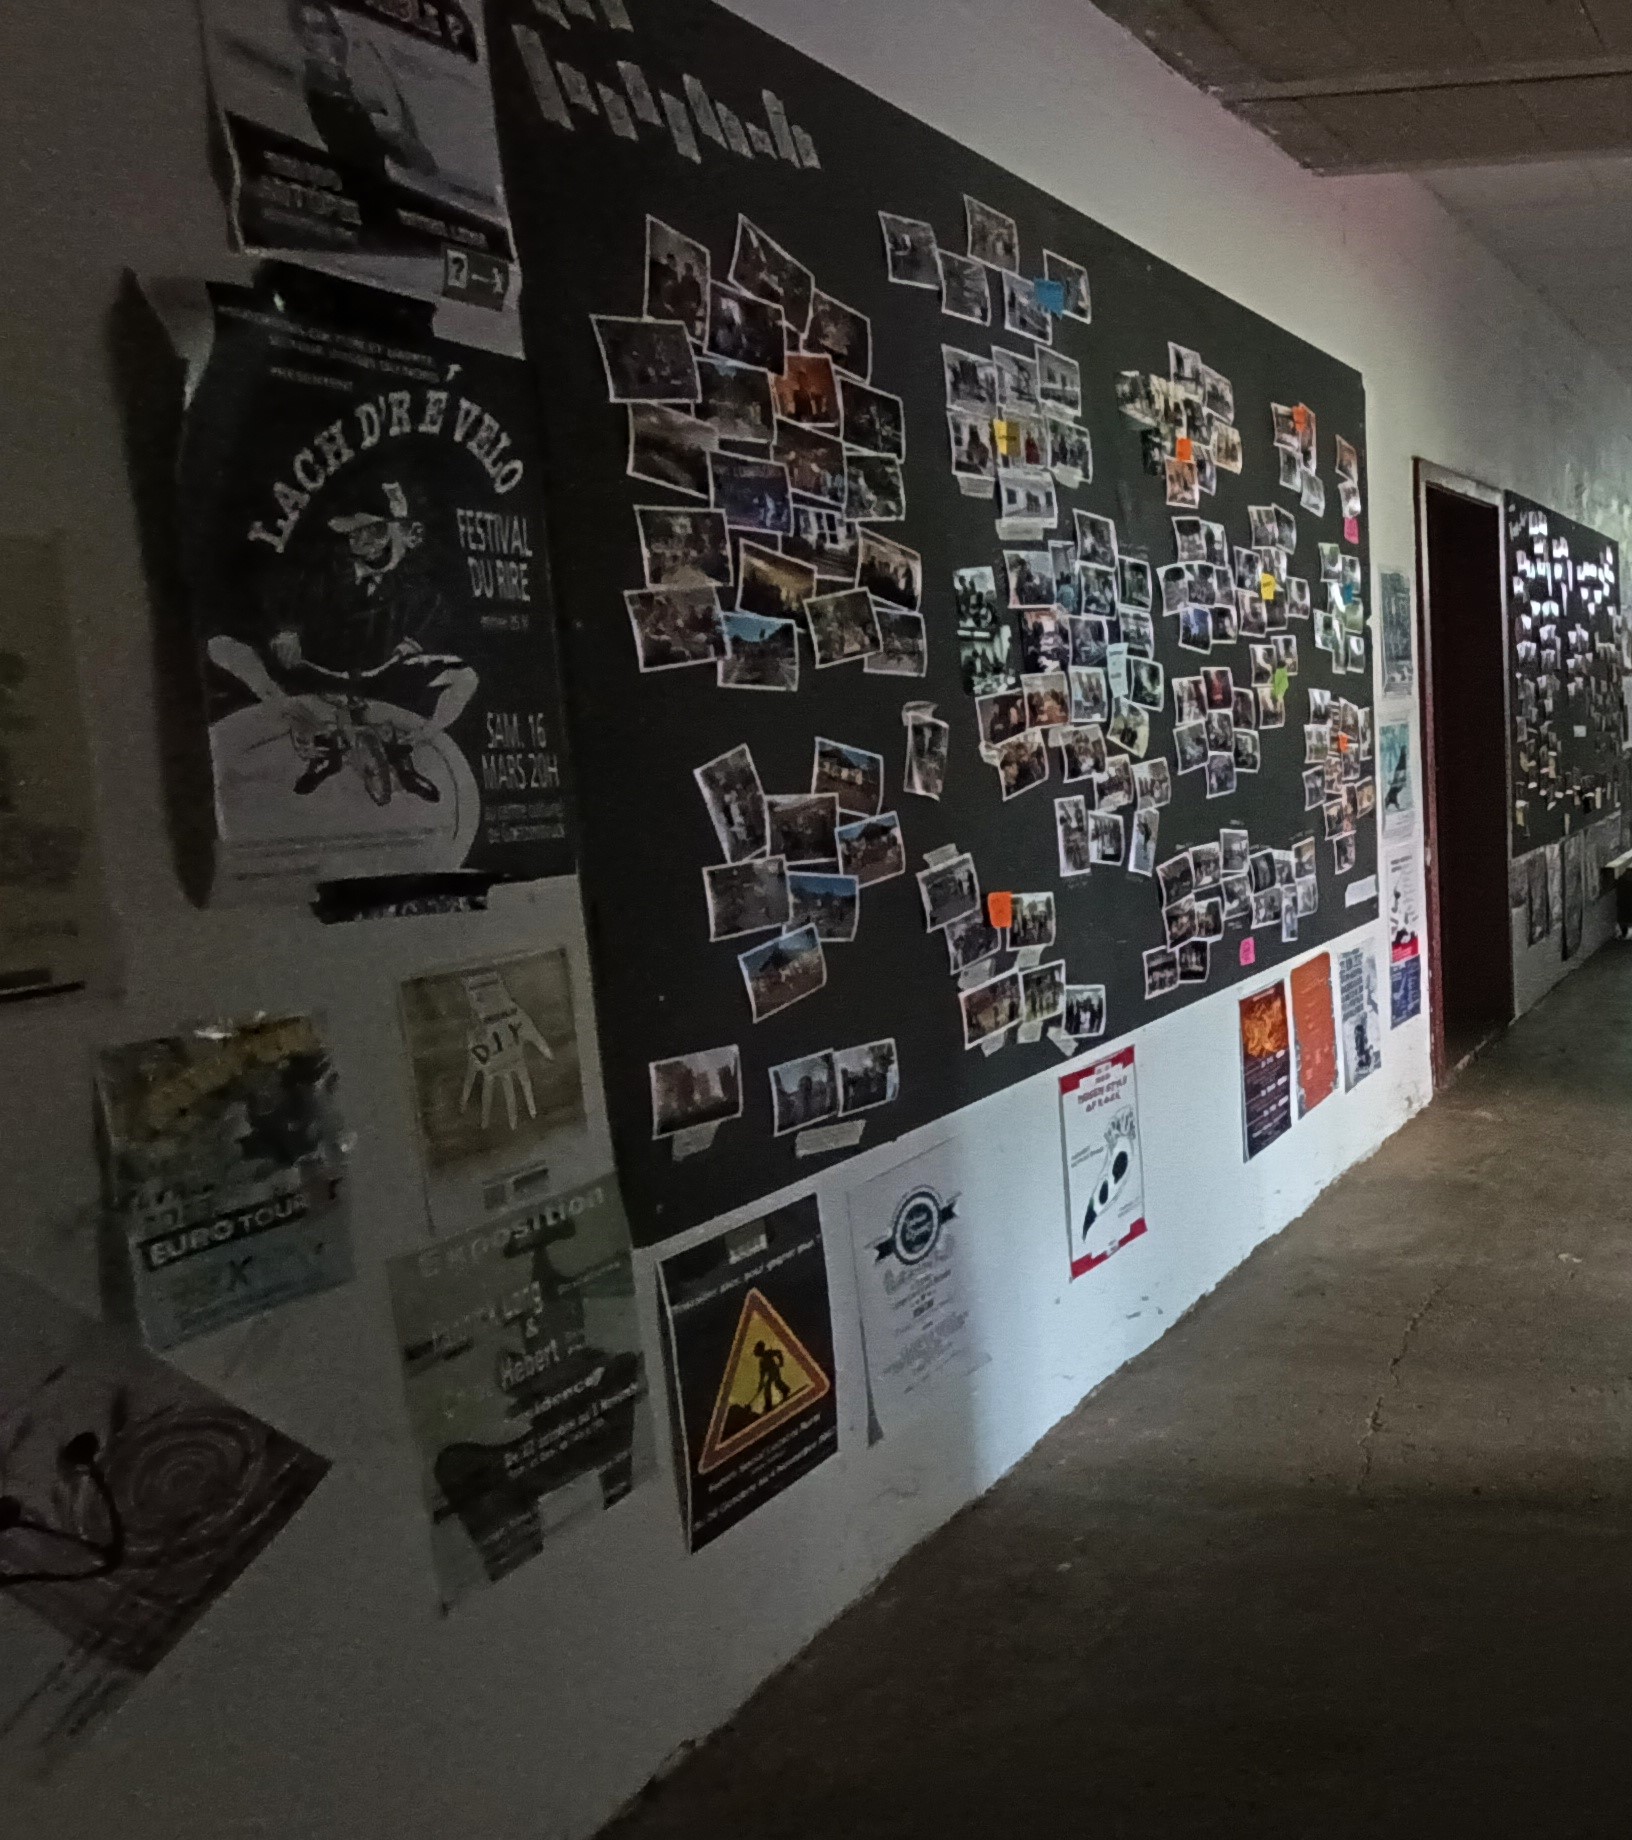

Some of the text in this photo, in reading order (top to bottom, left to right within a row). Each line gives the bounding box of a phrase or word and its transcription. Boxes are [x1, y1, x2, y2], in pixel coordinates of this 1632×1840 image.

[247, 418, 355, 554] LACH
[456, 508, 533, 557] FESTIVAL
[467, 555, 531, 602] DU RIRE
[528, 711, 547, 749] 16
[481, 752, 526, 790] MARS
[472, 1021, 522, 1064] DIY
[149, 1220, 235, 1266] EURO
[238, 1194, 310, 1233] TOUR
